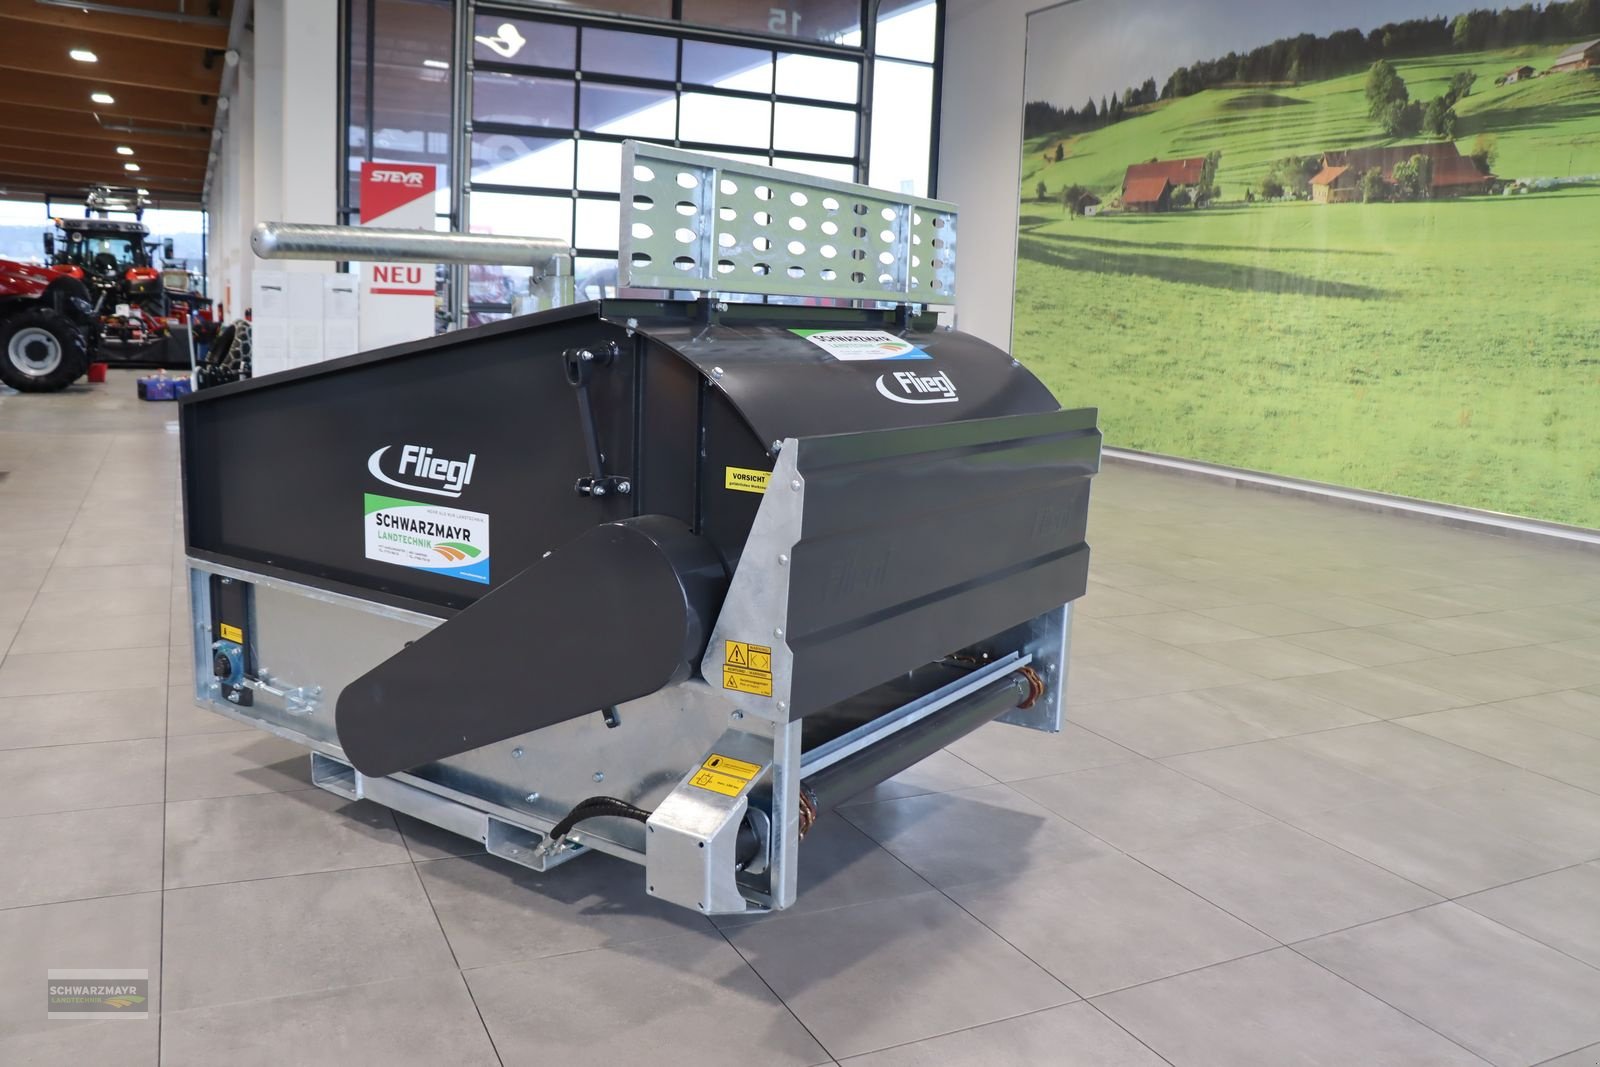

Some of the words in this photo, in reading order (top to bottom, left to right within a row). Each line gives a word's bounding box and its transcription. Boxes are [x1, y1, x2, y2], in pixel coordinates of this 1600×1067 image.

[370, 170, 424, 184] STEYR
[373, 265, 422, 284] NEU
[892, 370, 957, 398] Fliegl
[398, 444, 476, 492] Fliegl
[732, 472, 766, 483] VORSICHT
[375, 512, 471, 542] SCHWARZMAYR
[377, 530, 432, 549] LANDTECHNIK
